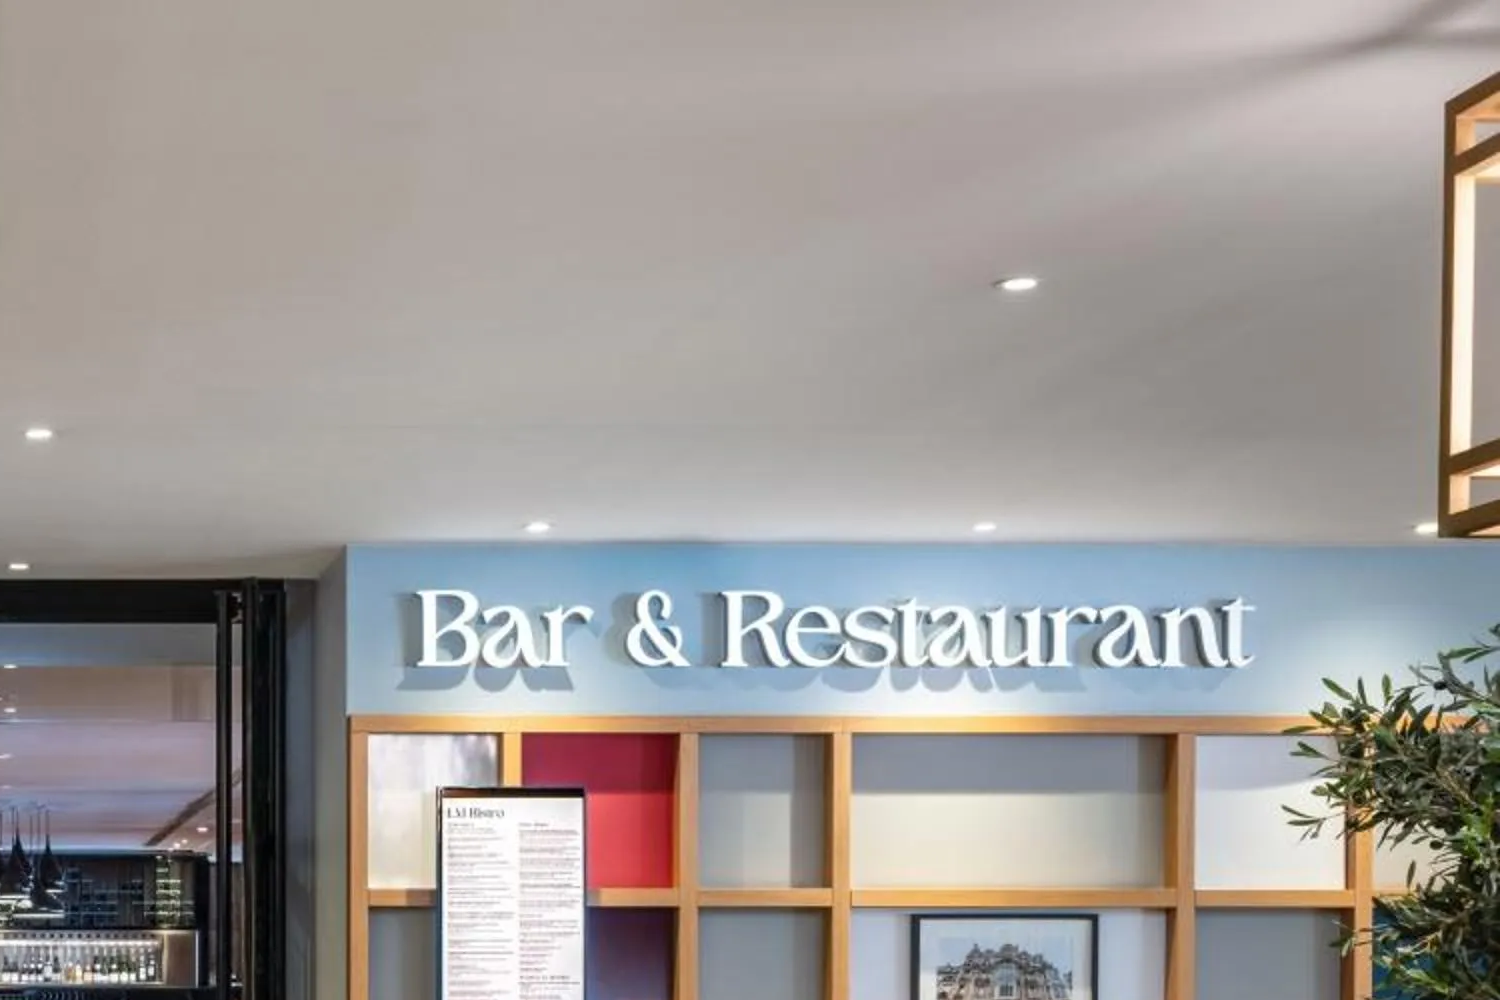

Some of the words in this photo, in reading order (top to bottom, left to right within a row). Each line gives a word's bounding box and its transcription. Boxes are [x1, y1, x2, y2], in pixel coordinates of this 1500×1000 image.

[415, 589, 596, 669] Bar
[625, 589, 692, 667] &
[719, 589, 1257, 669] Restaurant
